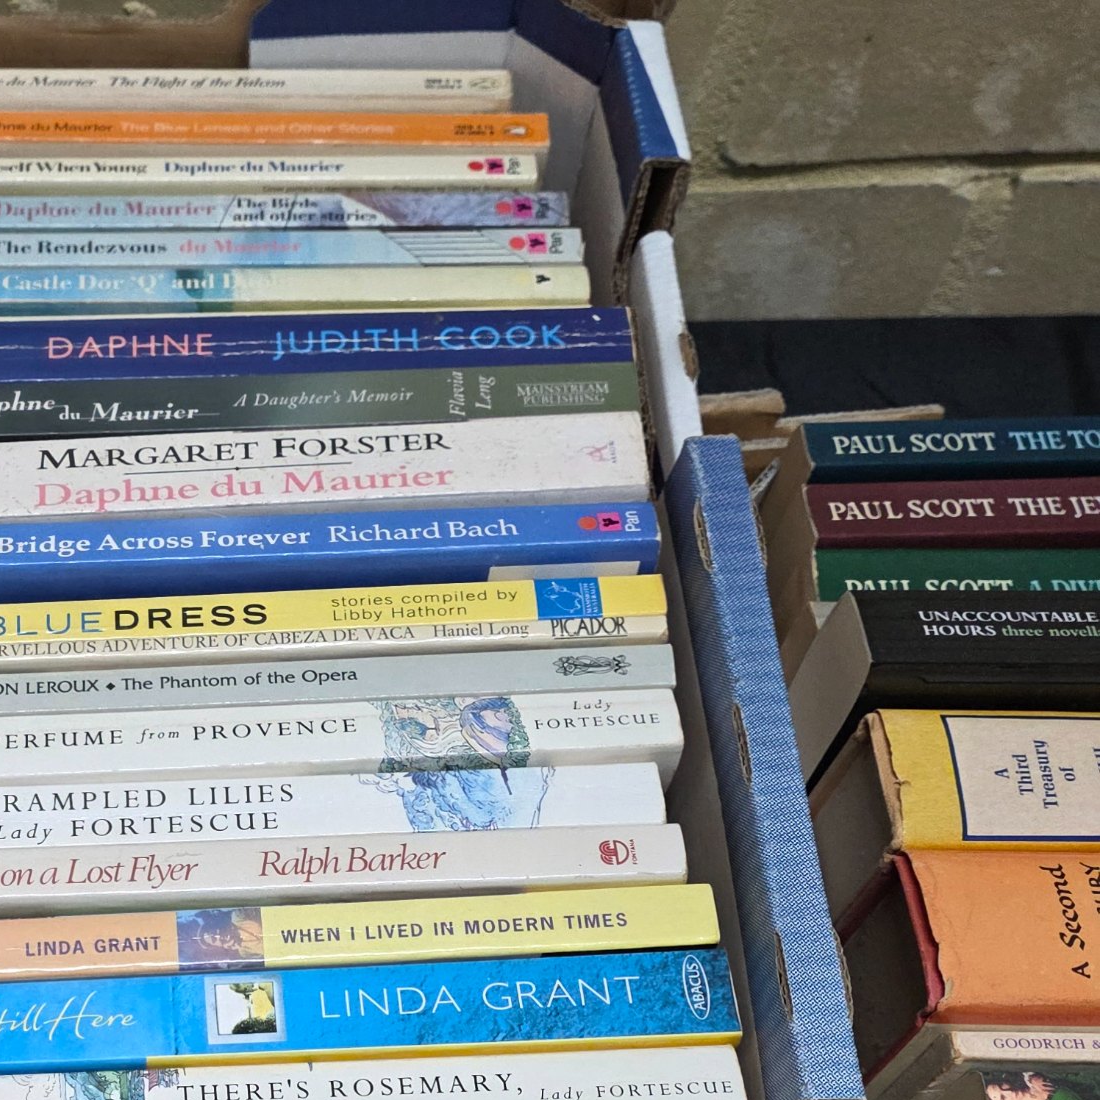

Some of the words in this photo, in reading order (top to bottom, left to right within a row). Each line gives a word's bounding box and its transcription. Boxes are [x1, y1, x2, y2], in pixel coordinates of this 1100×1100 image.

[37, 161, 93, 173] When
[94, 161, 147, 174] Young
[164, 161, 237, 176] Daphne
[241, 161, 264, 172] du
[269, 160, 344, 173] Maurier
[37, 240, 167, 254] Rendezvous
[48, 334, 213, 359] DAPHNE
[272, 328, 419, 360] JUDITH
[439, 324, 566, 350] COOK
[234, 394, 247, 407] A
[253, 389, 342, 410] Daughter's
[347, 389, 414, 403] Memoir
[448, 371, 466, 416] Flavia
[475, 374, 496, 410] Leng
[59, 405, 81, 421] du
[90, 402, 199, 422] Maurier
[38, 441, 259, 470] MARGARET
[272, 432, 452, 458] FORSTER
[833, 435, 906, 455] PAUL
[909, 432, 996, 452] SCOTT
[1009, 431, 1066, 450] THE
[34, 479, 199, 513] Daphne
[210, 474, 262, 498] du
[281, 467, 454, 494] Maurier
[625, 510, 642, 532] Pan
[97, 534, 193, 551] Across
[200, 529, 311, 549] Forever
[328, 521, 441, 543] Richard
[447, 519, 519, 538] Bach
[115, 603, 269, 631] DRESS
[331, 594, 393, 608] stories
[401, 590, 492, 606] compiled
[496, 589, 517, 602] by
[333, 607, 382, 622] Libby
[391, 604, 467, 618] Hathorn
[918, 611, 1099, 623] UNACCOUNTABLE
[924, 625, 996, 636] HOURS
[1002, 625, 1044, 636] three
[136, 728, 180, 744] from
[192, 717, 358, 741] PROVENCE
[994, 768, 1010, 779] A
[1013, 754, 1034, 796] Third
[1034, 740, 1059, 809] Treasury
[1057, 766, 1076, 782] of
[25, 940, 85, 957] LINDA
[94, 936, 161, 954] GRANT
[281, 926, 341, 945] WHEN
[350, 925, 356, 941] I
[365, 923, 424, 940] LIVED
[433, 920, 454, 936] IN
[464, 915, 555, 935] MODERN
[563, 912, 628, 929] TIMES
[689, 962, 708, 1011] ABACUS
[40, 991, 137, 1042] Here
[319, 985, 462, 1019] LINDA
[482, 975, 640, 1012] GRANT
[993, 1037, 1086, 1050] GOODRICH
